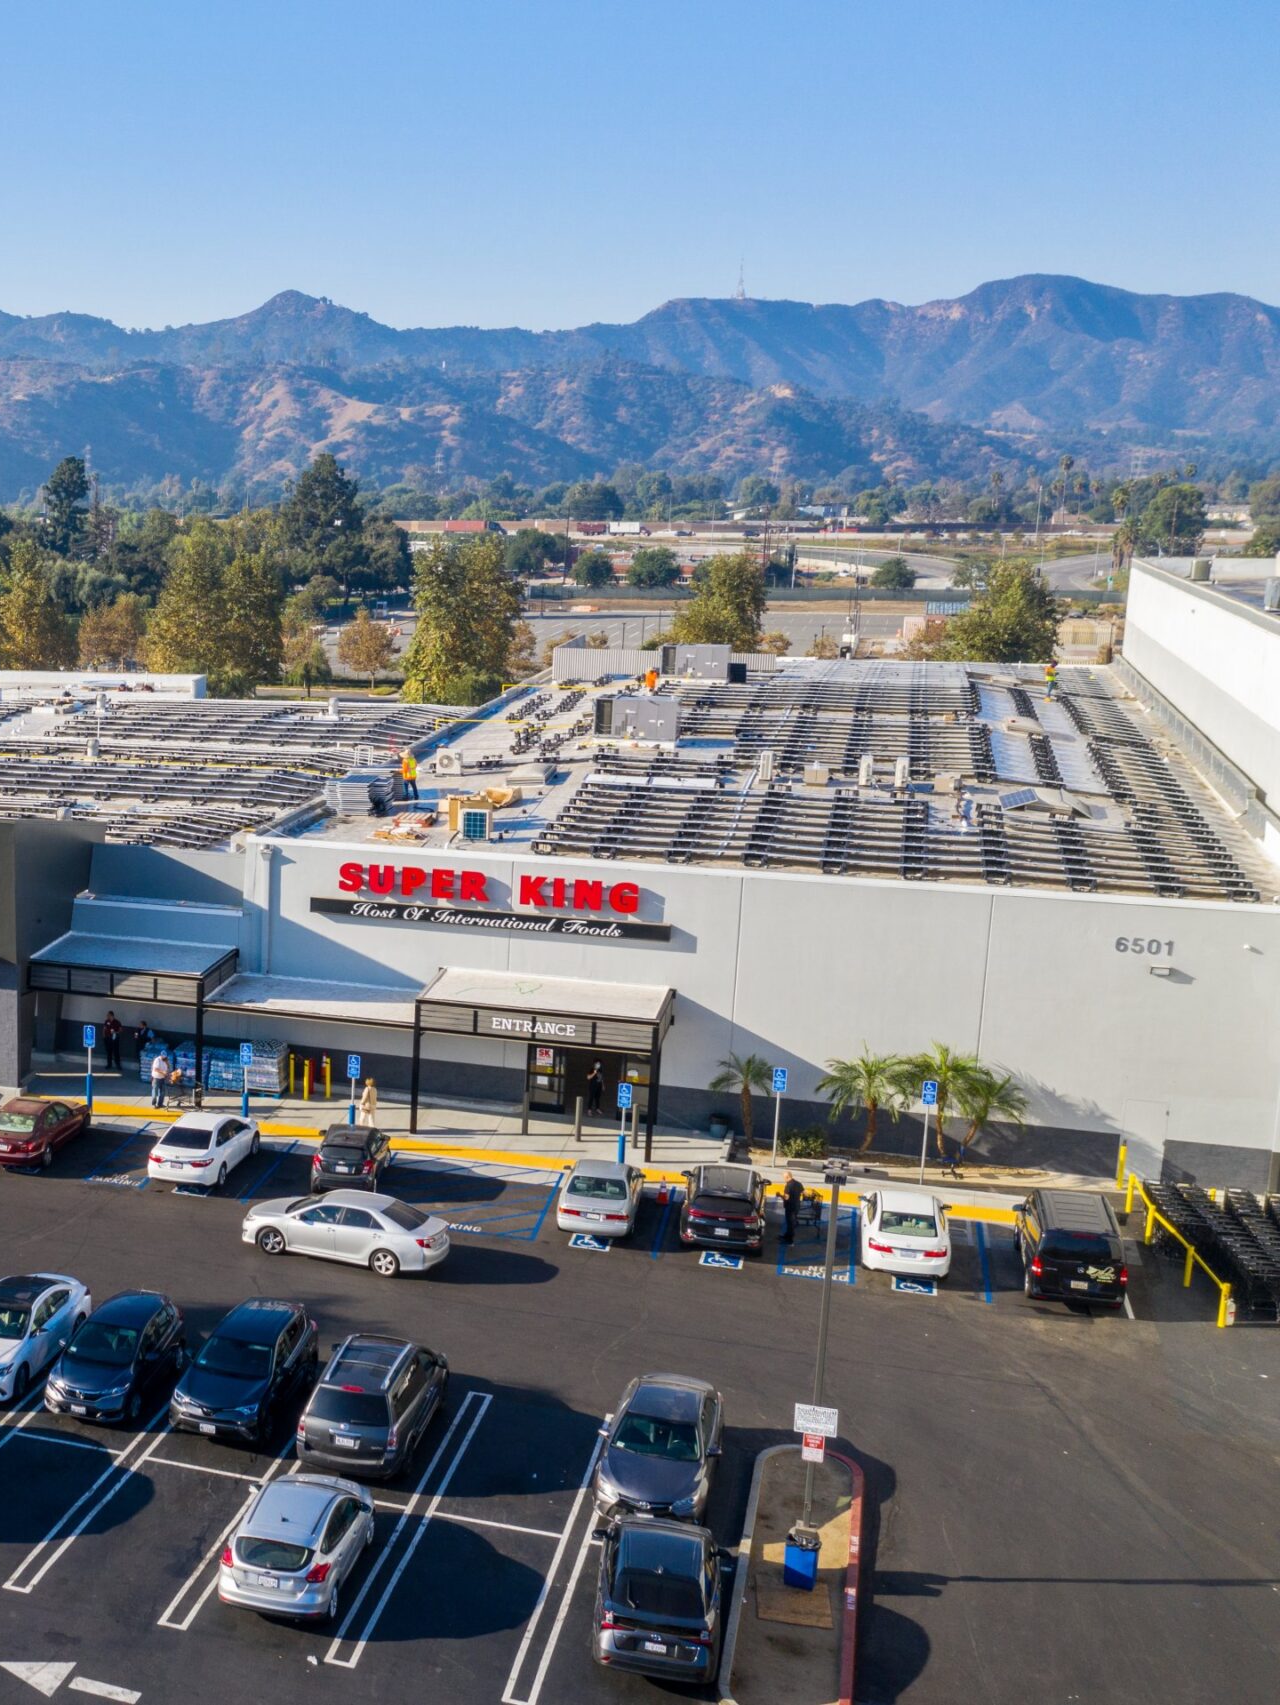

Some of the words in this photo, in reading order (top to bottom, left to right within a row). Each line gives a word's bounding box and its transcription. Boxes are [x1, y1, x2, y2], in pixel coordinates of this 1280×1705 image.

[339, 862, 490, 903] SUPER
[520, 875, 640, 914] KING
[350, 902, 398, 919] Host
[403, 907, 430, 921] Of
[431, 909, 557, 932] International
[562, 920, 624, 937] Foods
[1115, 937, 1175, 956] 6501
[492, 1018, 576, 1036] ENTRANCE
[449, 1223, 482, 1233] KING
